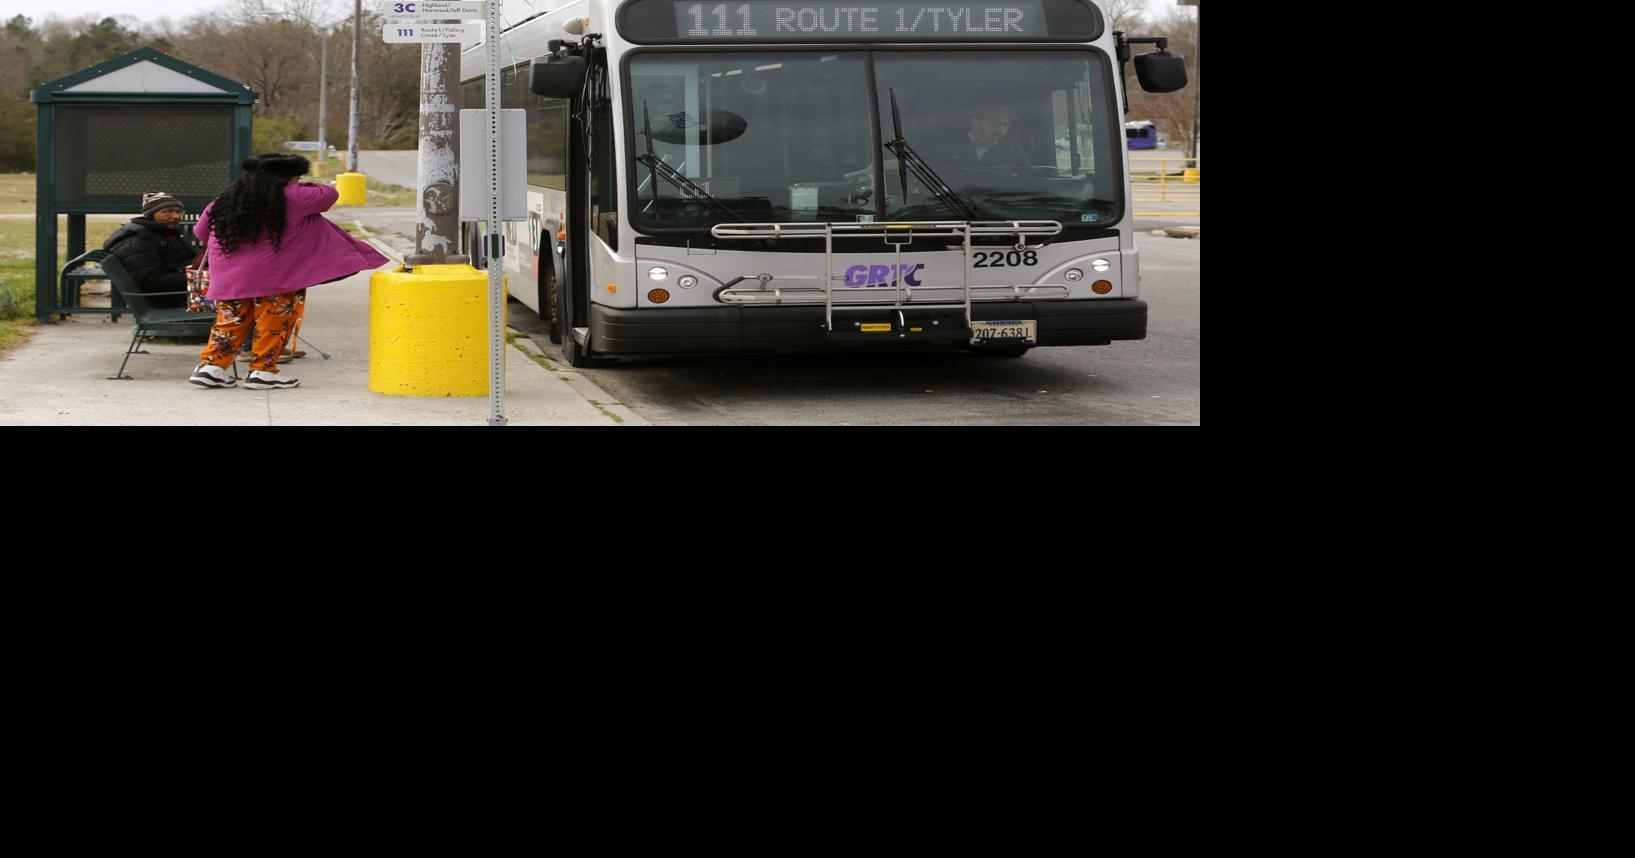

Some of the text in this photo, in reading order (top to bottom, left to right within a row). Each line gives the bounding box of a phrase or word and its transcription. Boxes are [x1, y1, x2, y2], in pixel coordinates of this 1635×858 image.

[393, 3, 416, 13] 3C
[688, 3, 1024, 36] 111 ROUTE 1/TYLER
[972, 251, 1038, 268] 2208
[843, 264, 924, 287] GRTC
